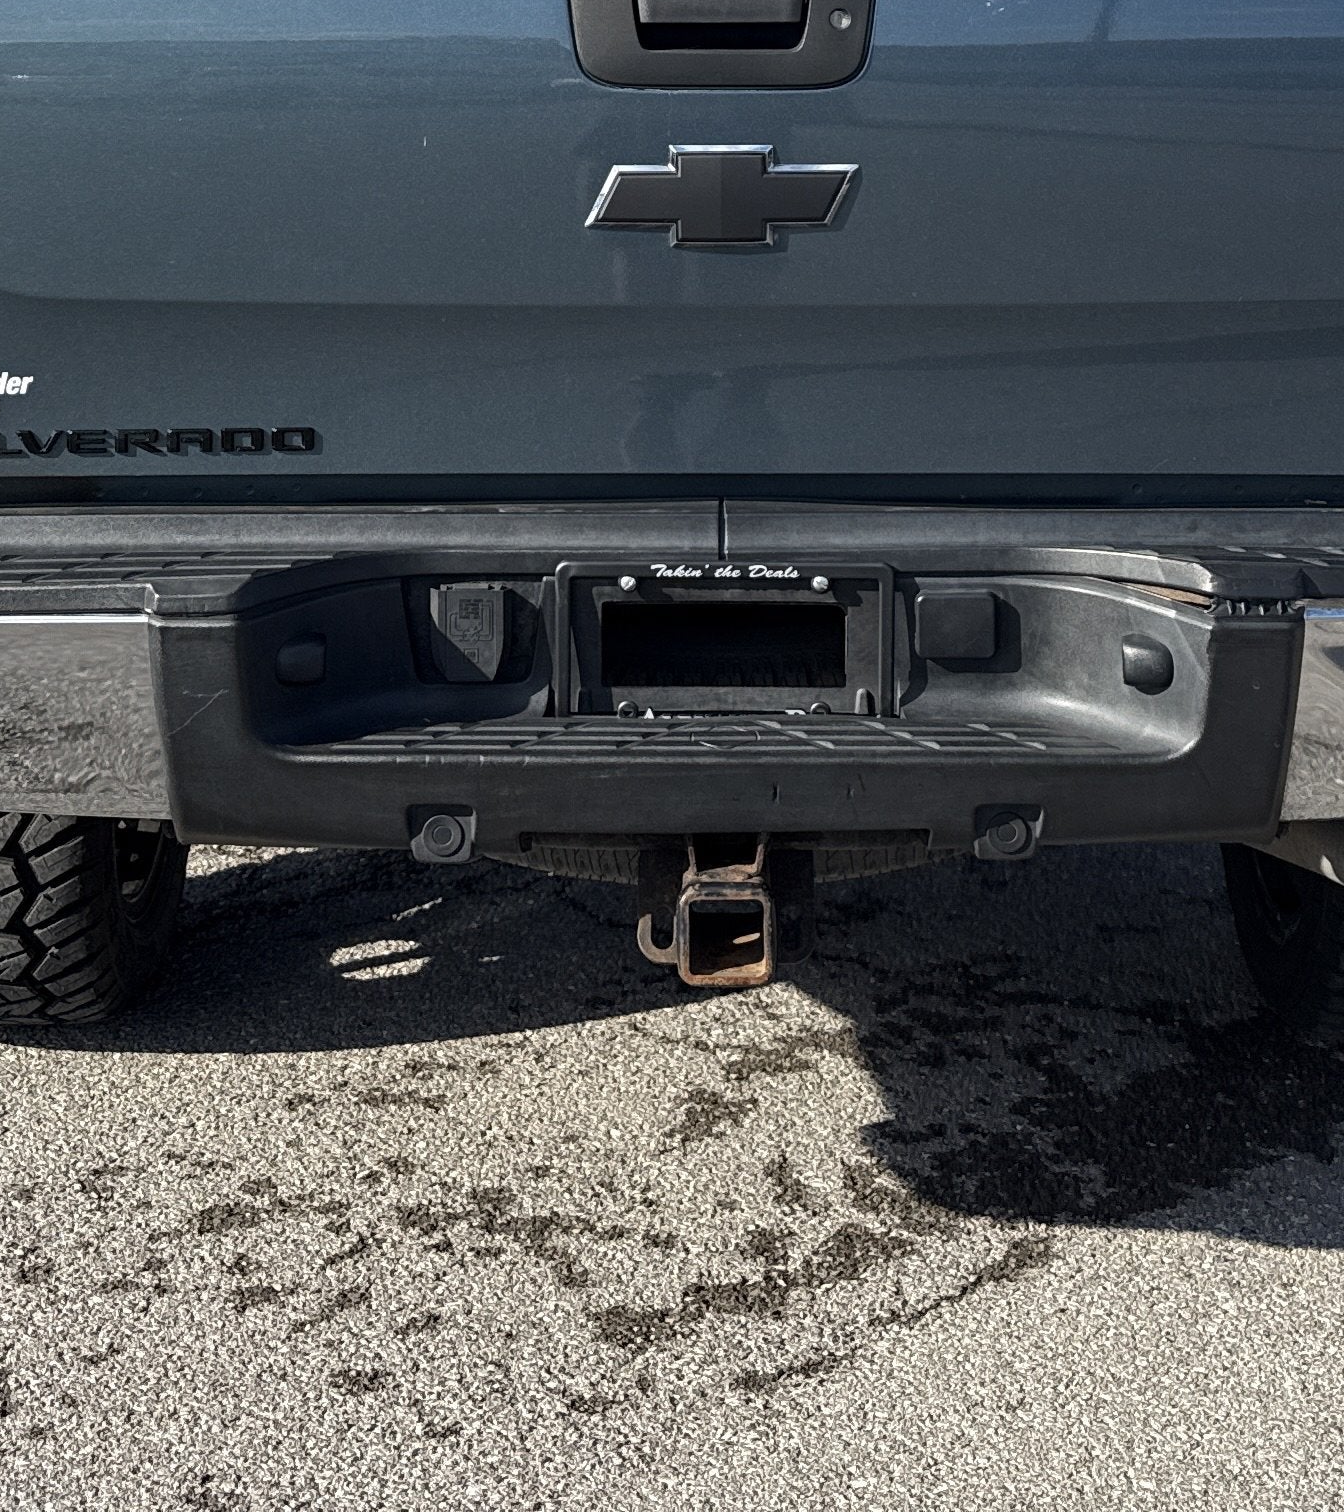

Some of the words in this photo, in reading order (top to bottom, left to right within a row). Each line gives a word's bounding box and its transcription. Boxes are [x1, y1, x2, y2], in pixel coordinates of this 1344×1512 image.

[650, 563, 710, 578] Takin'
[714, 564, 742, 578] the
[748, 564, 801, 579] Deals
